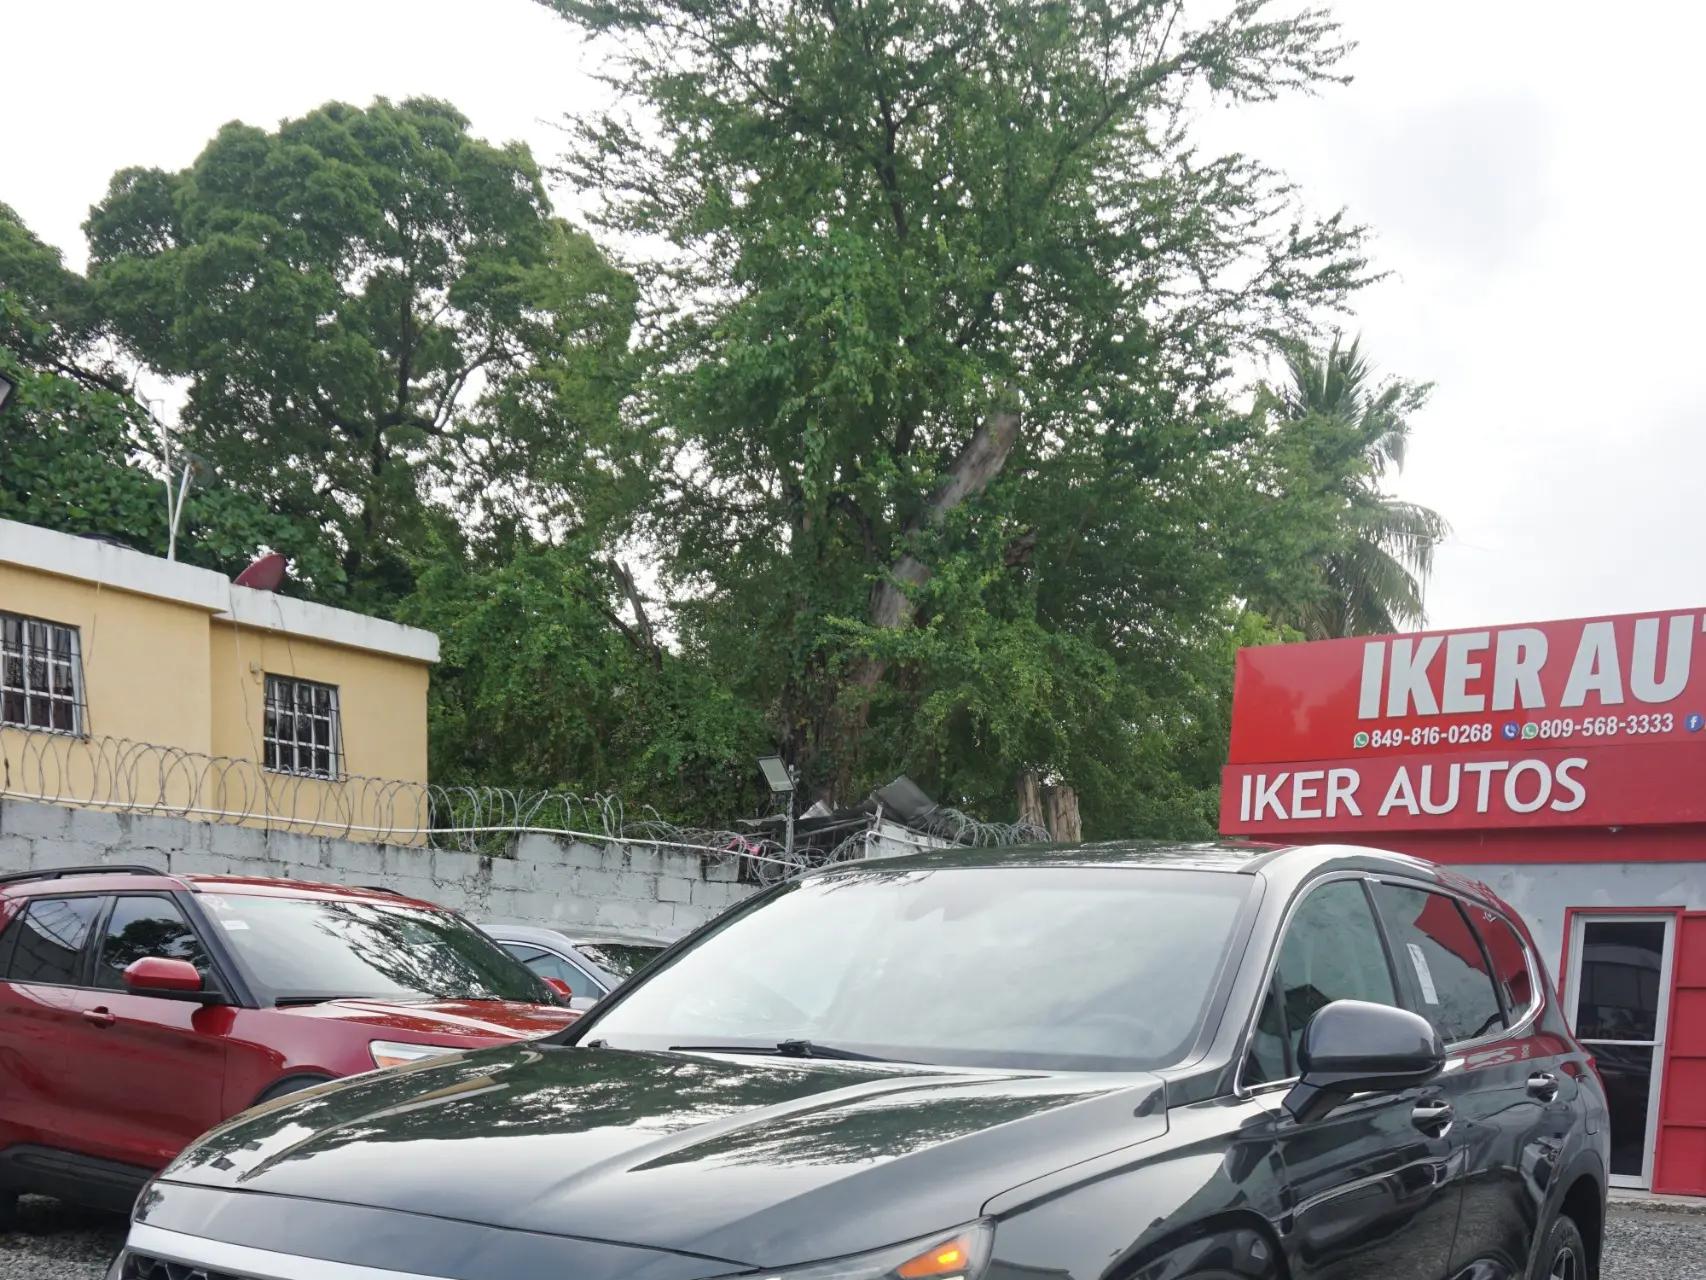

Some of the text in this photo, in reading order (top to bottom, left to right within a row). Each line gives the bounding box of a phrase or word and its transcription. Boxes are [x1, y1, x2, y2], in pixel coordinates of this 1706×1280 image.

[1358, 614, 1706, 719] IKER AU
[1371, 713, 1674, 748] 849-816-0268 809-568-3333
[1240, 757, 1589, 821] IKER AUTOS
